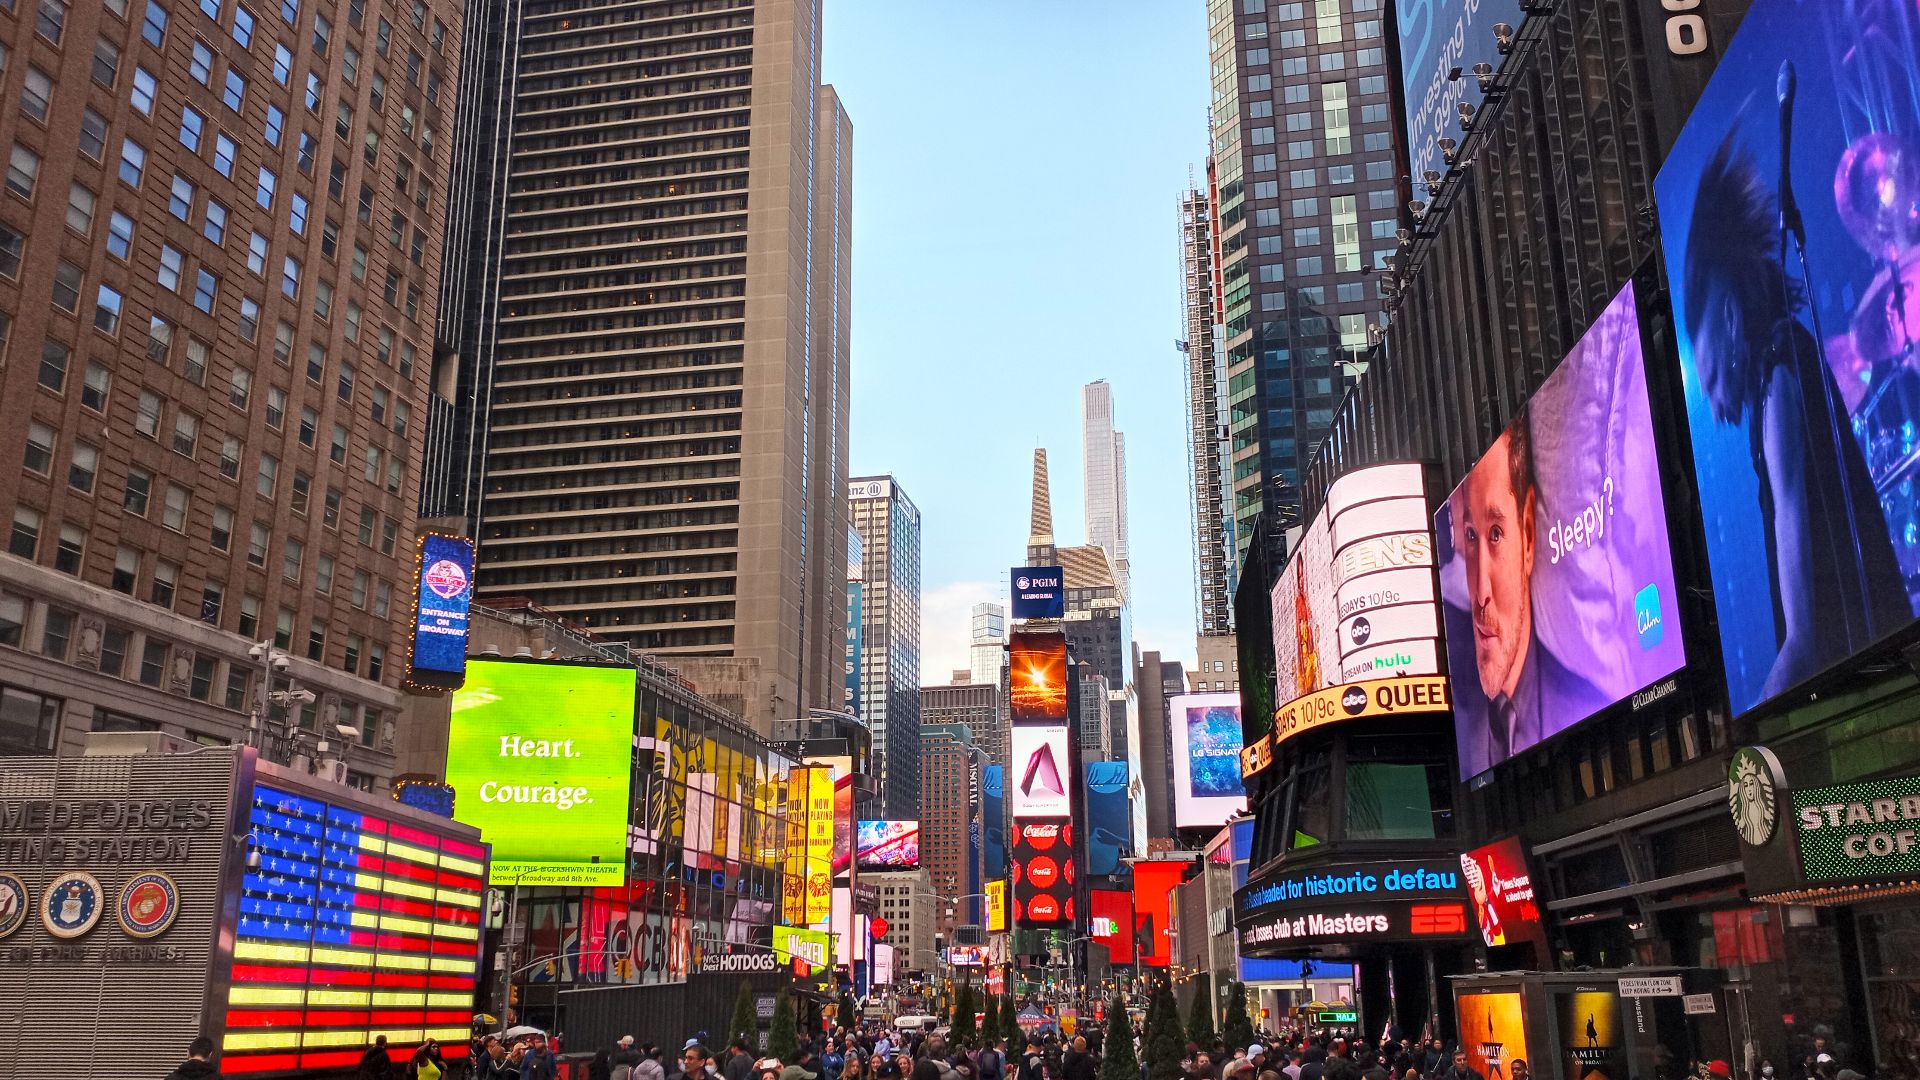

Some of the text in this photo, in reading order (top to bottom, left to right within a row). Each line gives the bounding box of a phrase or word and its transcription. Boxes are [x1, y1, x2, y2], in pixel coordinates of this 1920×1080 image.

[1411, 15, 1465, 149] Investing
[1415, 136, 1434, 180] the
[1549, 476, 1614, 564] Sleepy?
[1032, 578, 1058, 588] PGIM
[1368, 590, 1400, 607] 10/9c
[421, 608, 465, 620] ENTRANCE
[436, 618, 450, 626] ON
[1637, 608, 1661, 635] Calm
[419, 625, 465, 637] BROADWAY
[1351, 624, 1370, 637] abc
[1361, 661, 1373, 673] ON
[1375, 653, 1412, 669] hulu
[1301, 697, 1335, 725] 10/9c
[1342, 692, 1367, 707] abc
[499, 735, 581, 758] Heart.
[1193, 749, 1205, 757] LG
[479, 781, 594, 810] Courage.
[814, 798, 830, 809] NOW
[79, 799, 212, 829] FORCES
[810, 810, 833, 821] PLAYING
[1800, 794, 1920, 831] STARB
[816, 824, 825, 834] ON
[73, 836, 191, 862] STATION
[809, 838, 832, 847] BROADWAY
[586, 866, 618, 874] THEATRE
[521, 874, 555, 883] Broadway
[557, 874, 570, 882] and
[1501, 875, 1529, 890] Times Square
[1261, 880, 1287, 904] headed
[1287, 879, 1304, 899] for
[1305, 870, 1377, 897] historic
[1384, 868, 1457, 891] defau
[1273, 918, 1291, 939] club
[1293, 917, 1306, 937] at
[1308, 912, 1389, 936] Masters
[703, 954, 720, 963] NYC's
[703, 954, 775, 971] best HOTDOGS
[1620, 978, 1648, 987] PEDESTRIAN
[1660, 979, 1672, 987] ZONE
[1622, 987, 1651, 995] KEEP MOVING
[1477, 1044, 1510, 1057] HAMILTON
